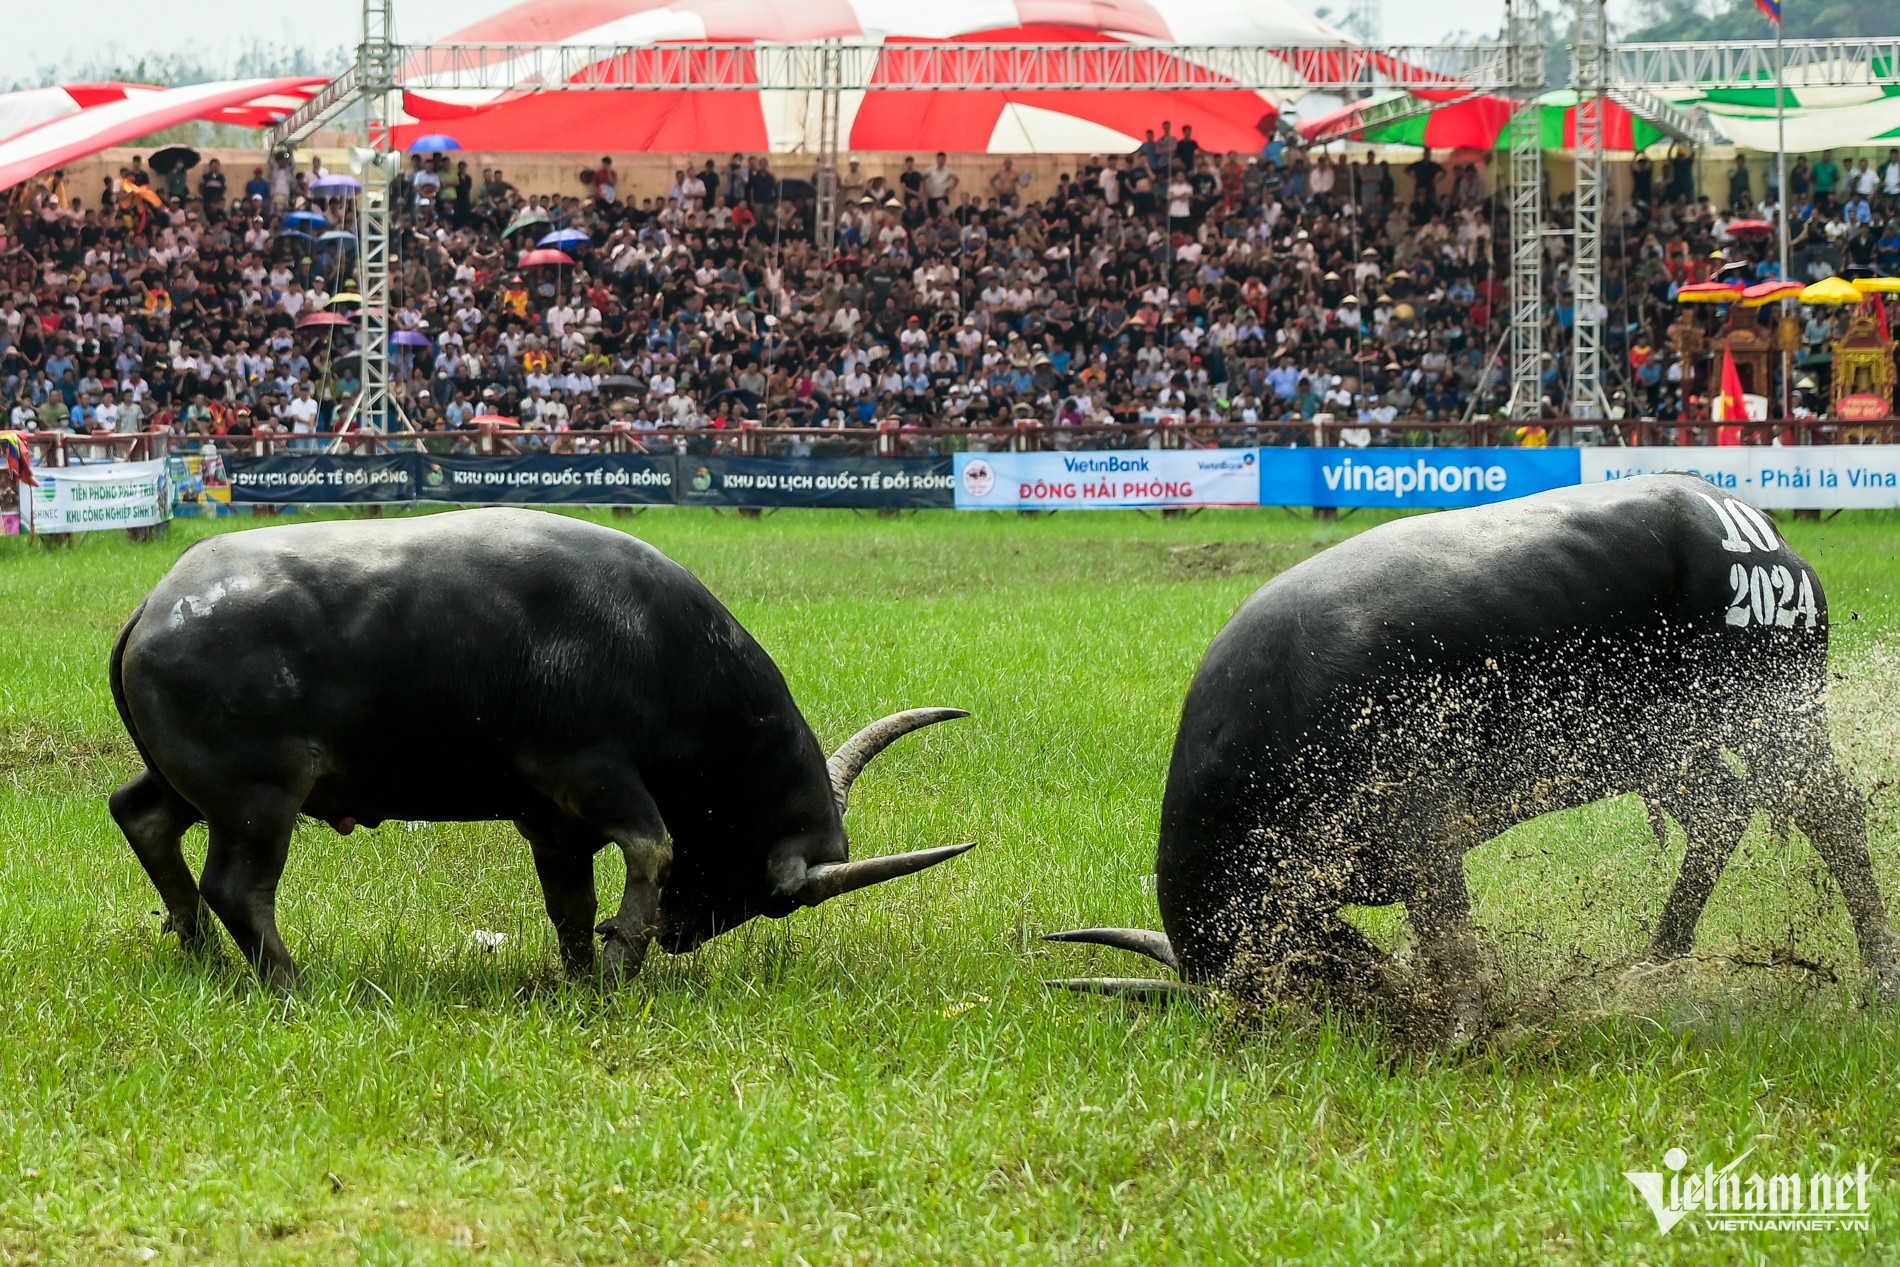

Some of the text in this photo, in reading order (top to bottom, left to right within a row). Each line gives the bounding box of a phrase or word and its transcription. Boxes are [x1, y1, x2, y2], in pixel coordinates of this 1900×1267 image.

[1064, 456, 1149, 473] VietinBank
[238, 473, 257, 485] DU
[258, 472, 287, 489] LỊCH
[289, 467, 325, 485] QUỐC
[327, 467, 343, 485] TẾ
[454, 470, 482, 485] KHU
[485, 471, 505, 485] DU
[507, 471, 539, 488] LỊCH
[543, 467, 582, 486] QUỐC
[585, 467, 603, 485] TẾ
[723, 474, 754, 488] KHU
[756, 474, 778, 489] DU
[780, 474, 813, 492] LỊCH
[816, 470, 858, 490] QUỐC
[861, 470, 880, 490] TẾ
[1019, 476, 1193, 499] ĐÔNG HẢI PHÒNG
[1321, 457, 1507, 498] vinaphone
[1761, 465, 1811, 488] Phải
[1820, 469, 1839, 488] là
[1847, 469, 1898, 488] Vina
[89, 485, 118, 501] PHONG
[32, 508, 58, 519] SHINEC
[66, 509, 81, 523] KHU
[82, 506, 104, 523] CÔNG
[133, 504, 149, 519] SINH
[1696, 491, 1780, 553] 10
[1725, 563, 1818, 628] 2024
